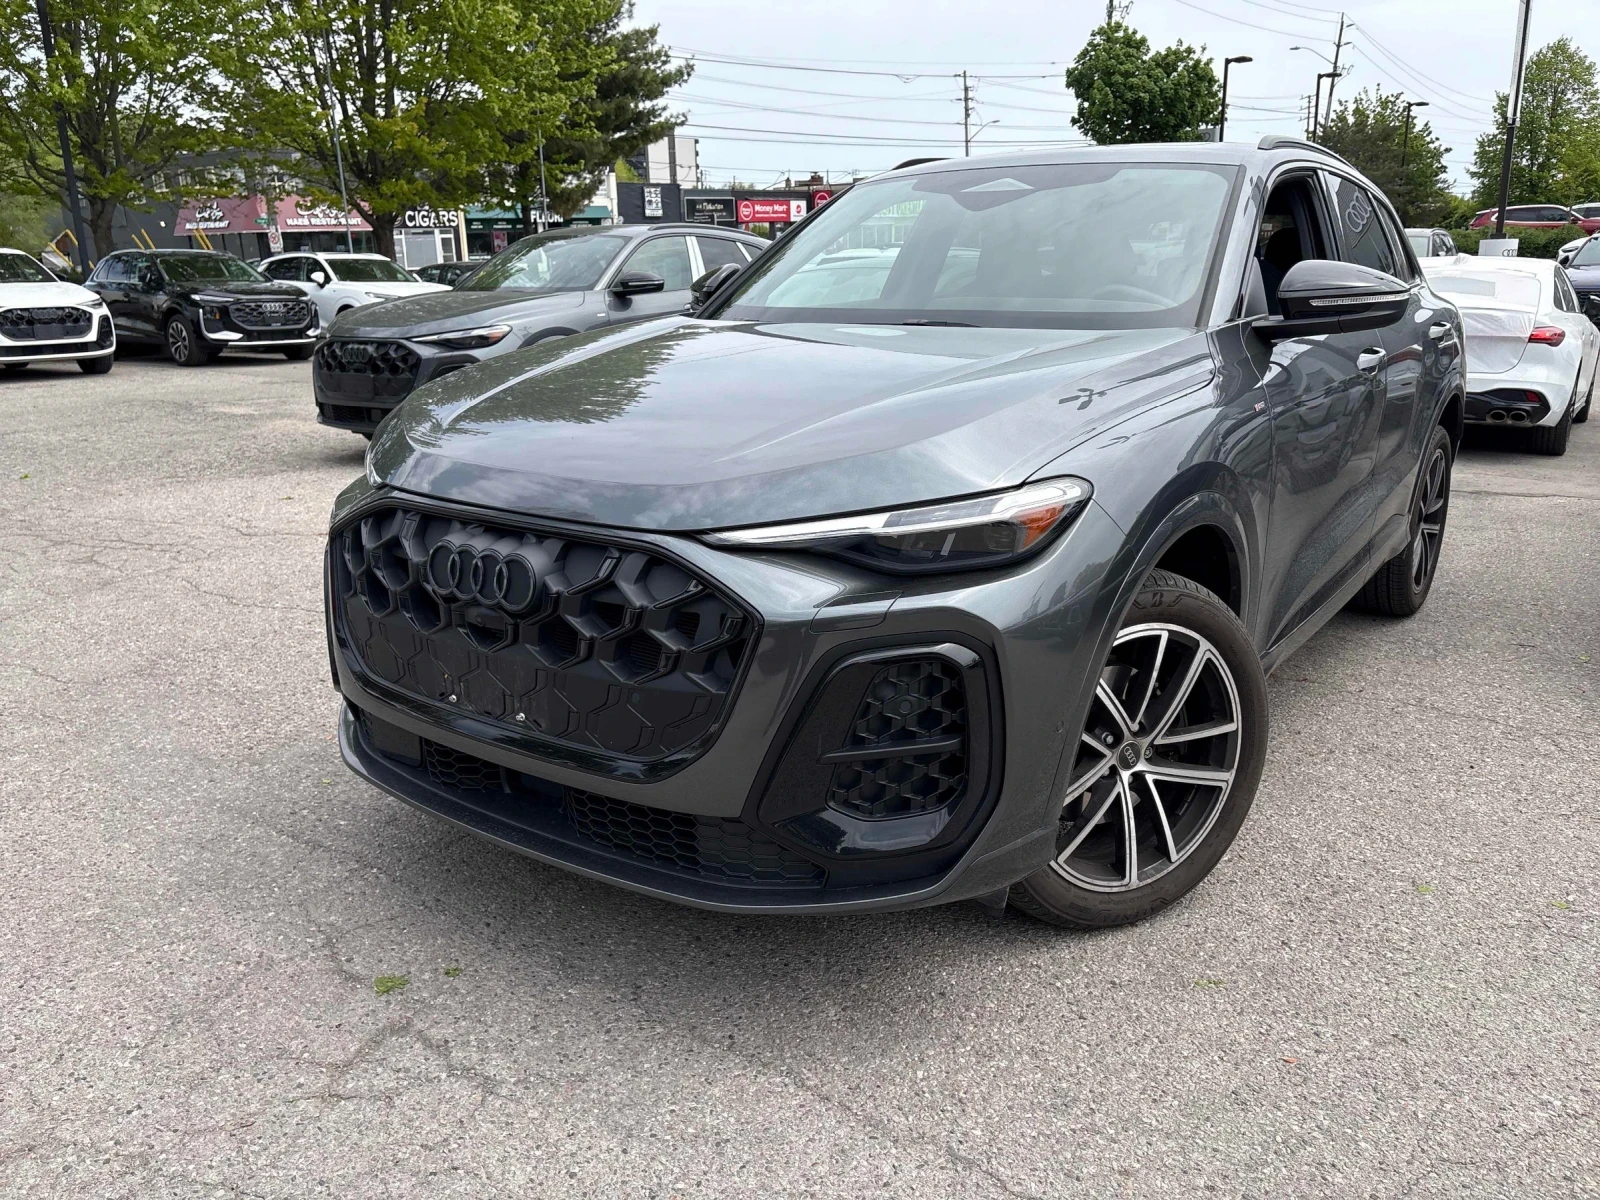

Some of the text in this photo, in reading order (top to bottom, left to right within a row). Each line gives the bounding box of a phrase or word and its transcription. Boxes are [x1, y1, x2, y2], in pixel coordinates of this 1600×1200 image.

[754, 204, 773, 213] Money
[773, 204, 787, 212] Mart
[405, 211, 458, 227] CIGARS
